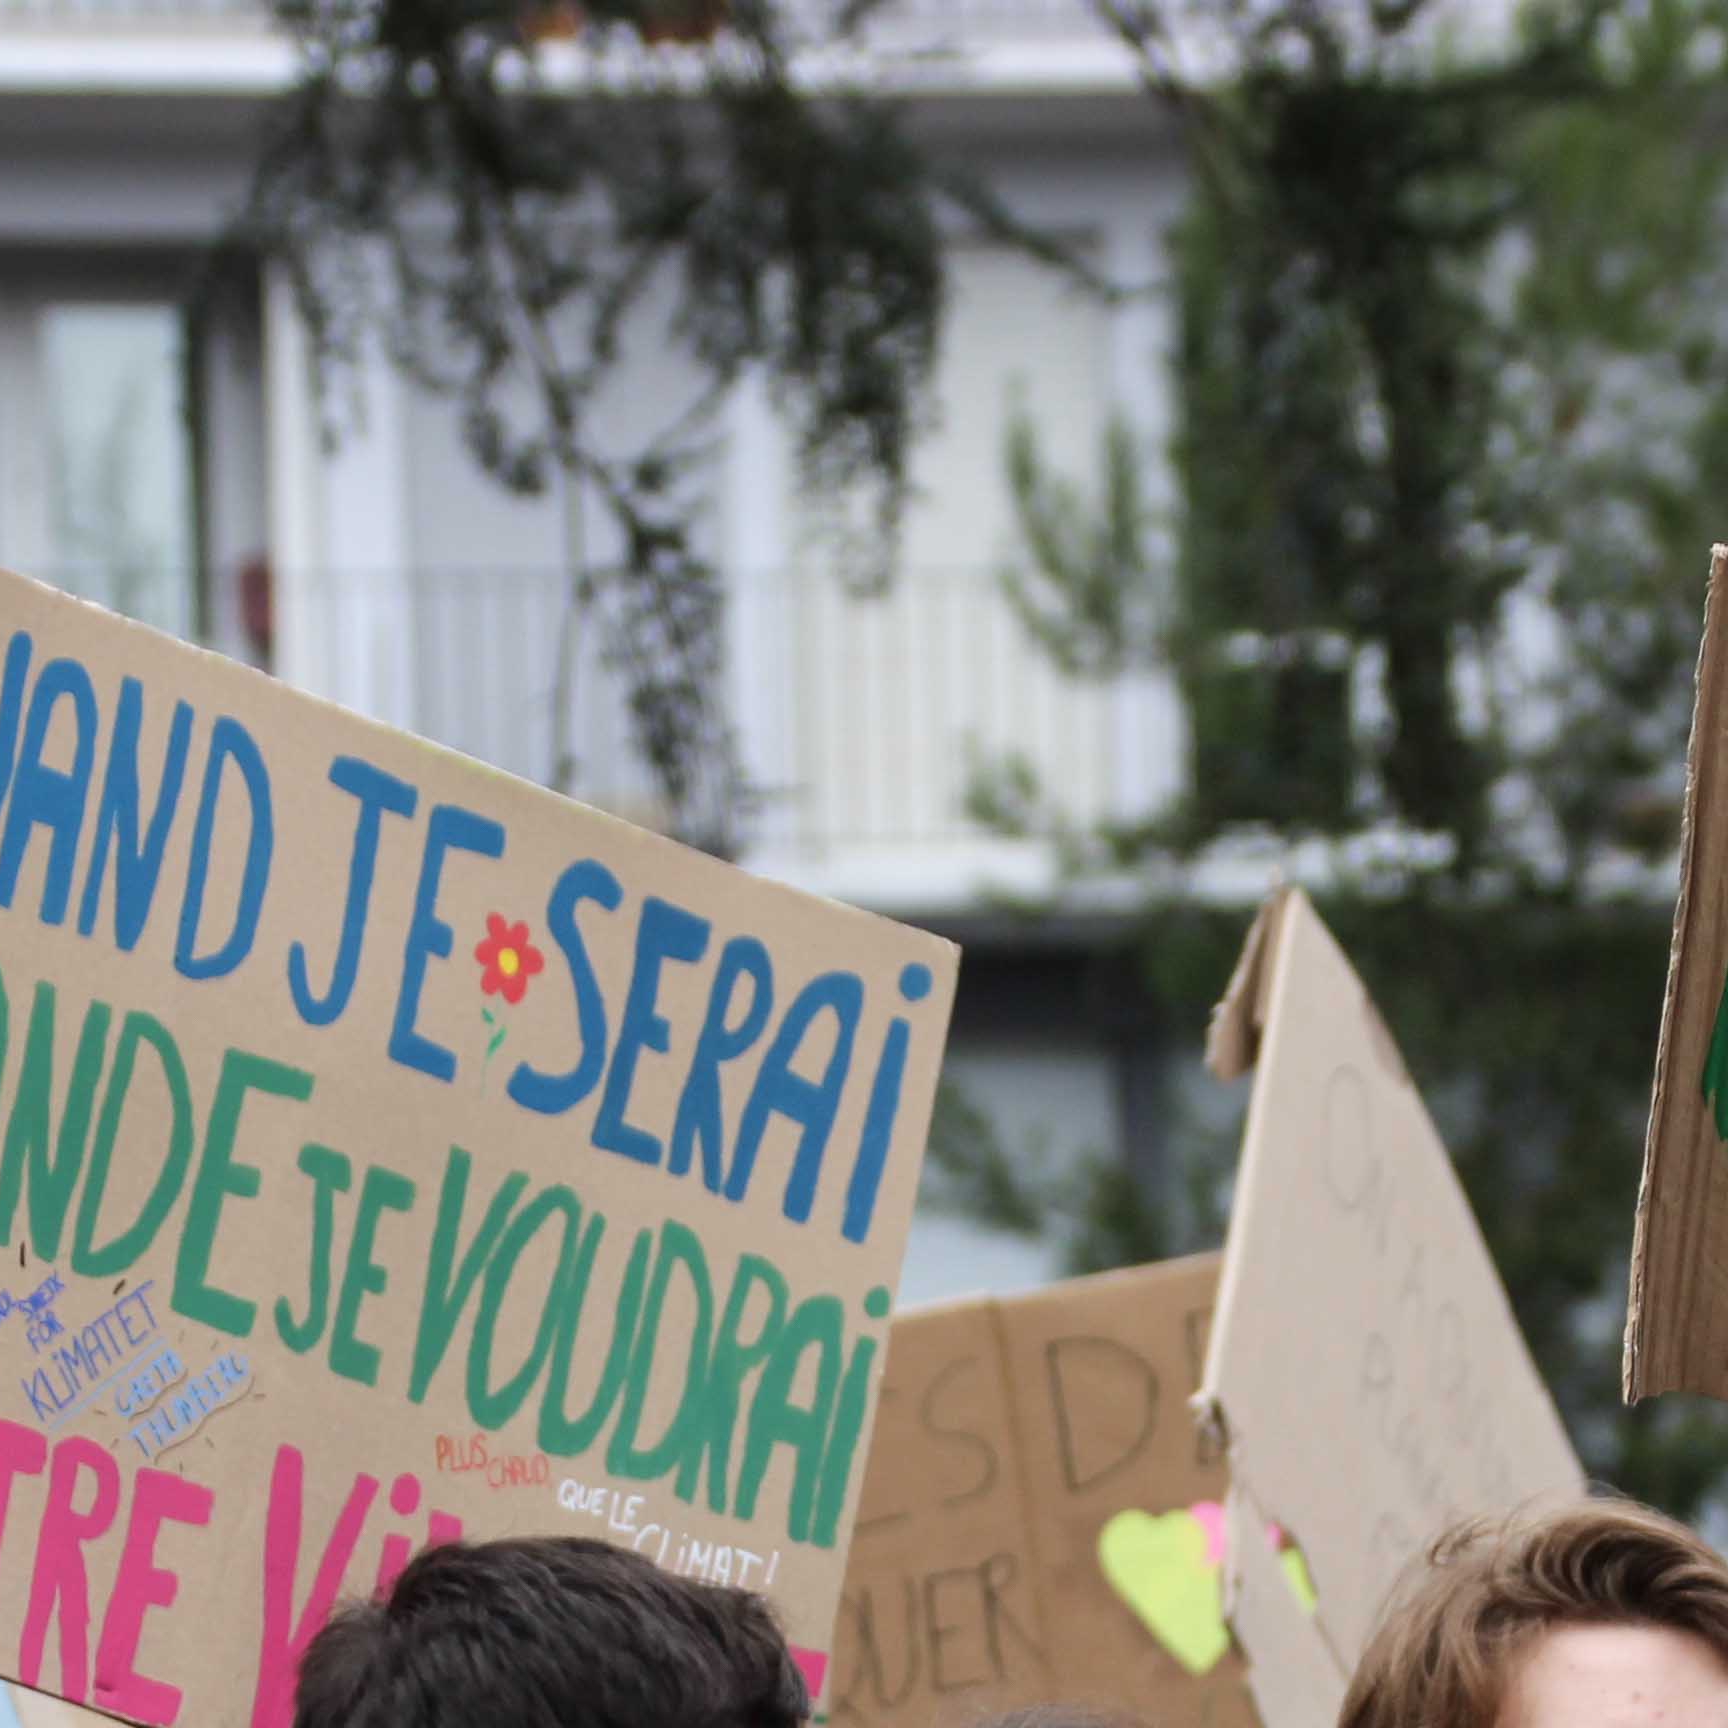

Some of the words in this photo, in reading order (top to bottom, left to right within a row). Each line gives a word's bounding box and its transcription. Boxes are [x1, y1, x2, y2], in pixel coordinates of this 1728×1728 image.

[287, 753, 508, 1084] JE
[273, 1141, 417, 1386] JE
[434, 1433, 487, 1475] PLUS
[557, 1477, 606, 1519] QUE
[609, 1491, 645, 1532] LE
